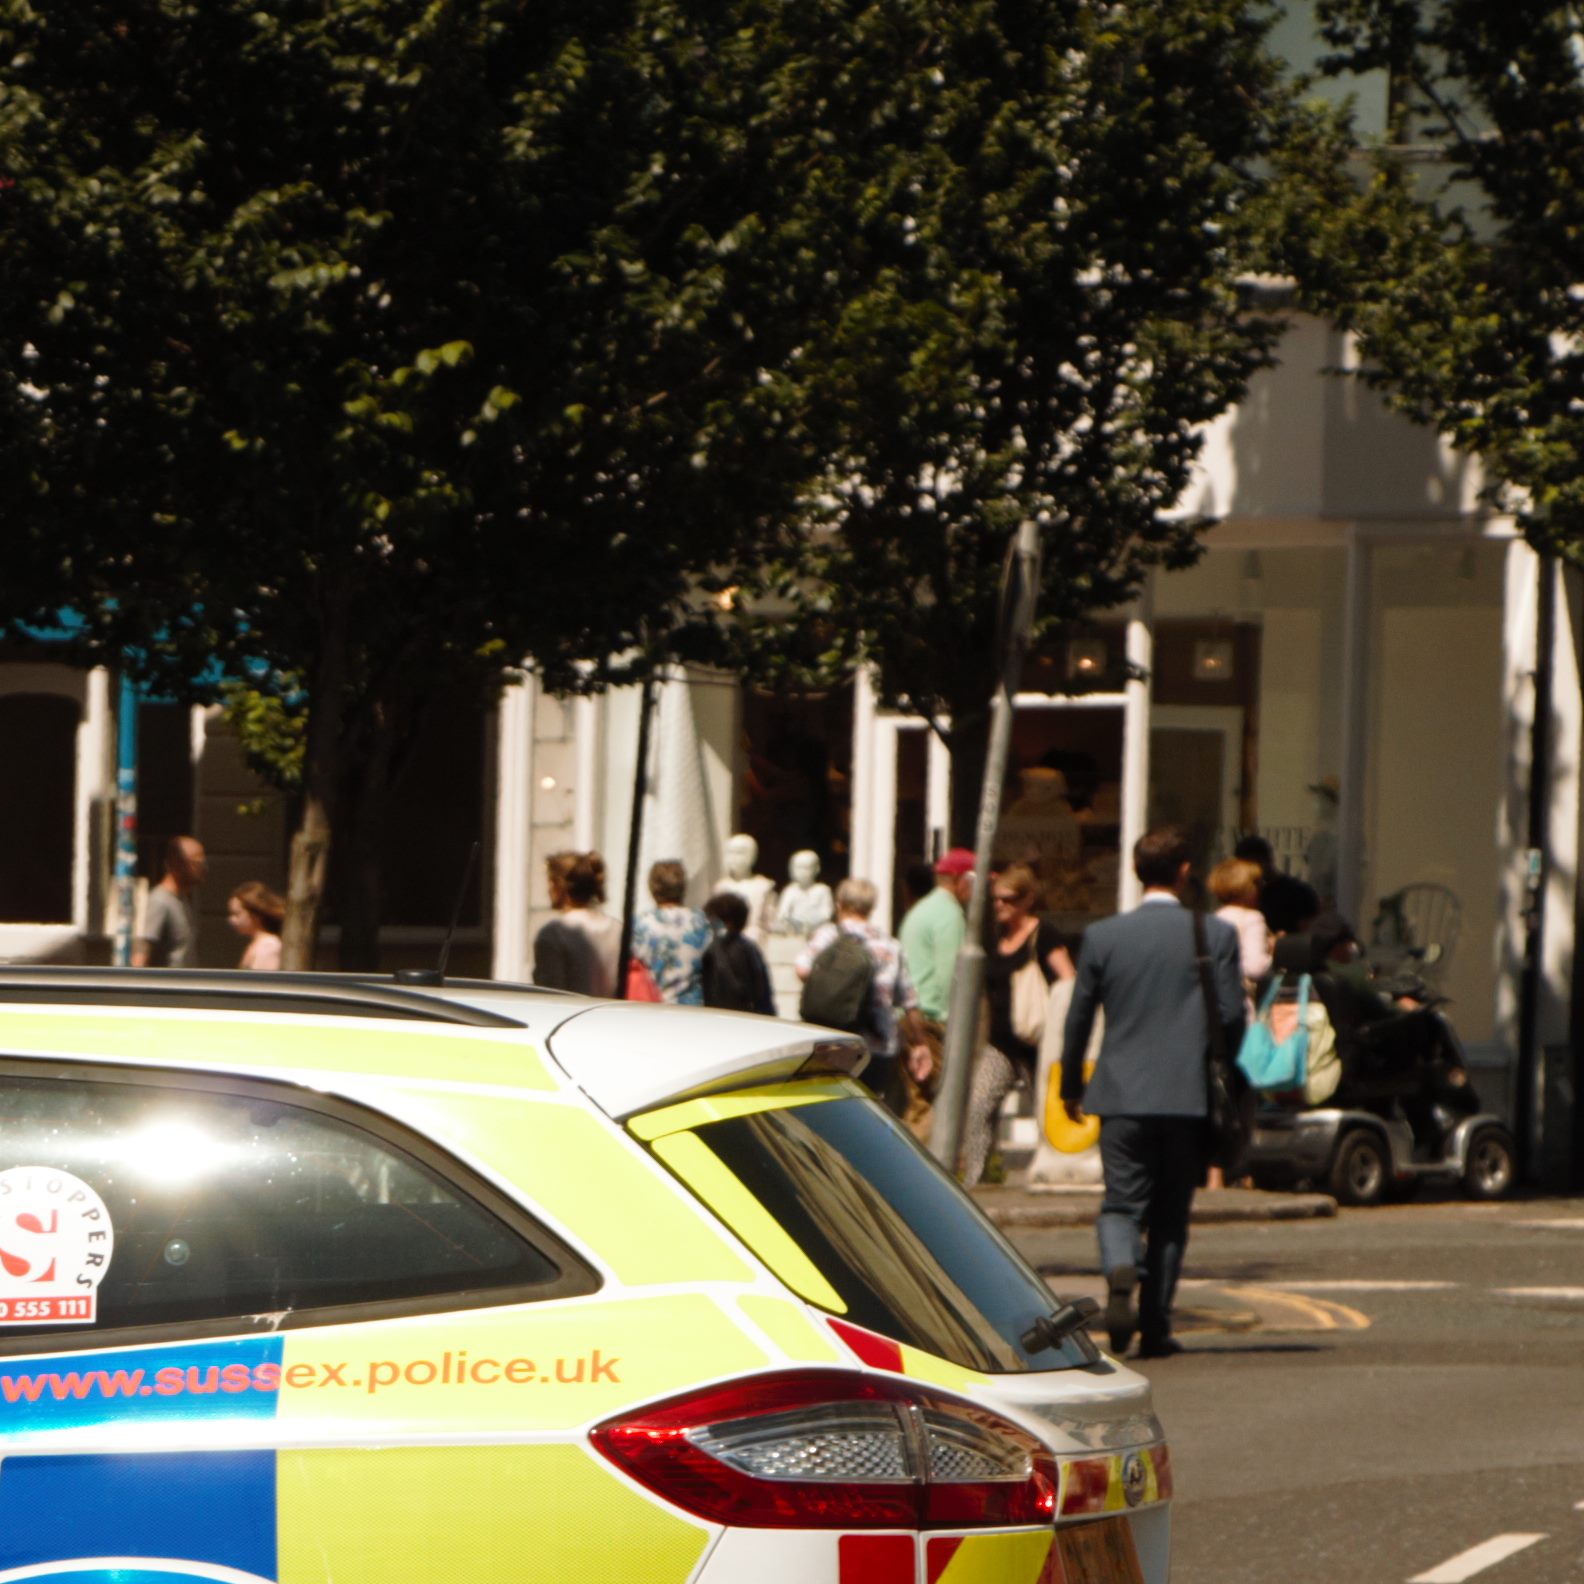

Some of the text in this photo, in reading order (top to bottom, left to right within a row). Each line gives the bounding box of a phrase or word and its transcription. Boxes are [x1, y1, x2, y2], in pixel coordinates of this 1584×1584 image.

[13, 1301, 51, 1318] 555
[58, 1299, 87, 1316] 111
[0, 1349, 622, 1403] www.sussex.police.uk
